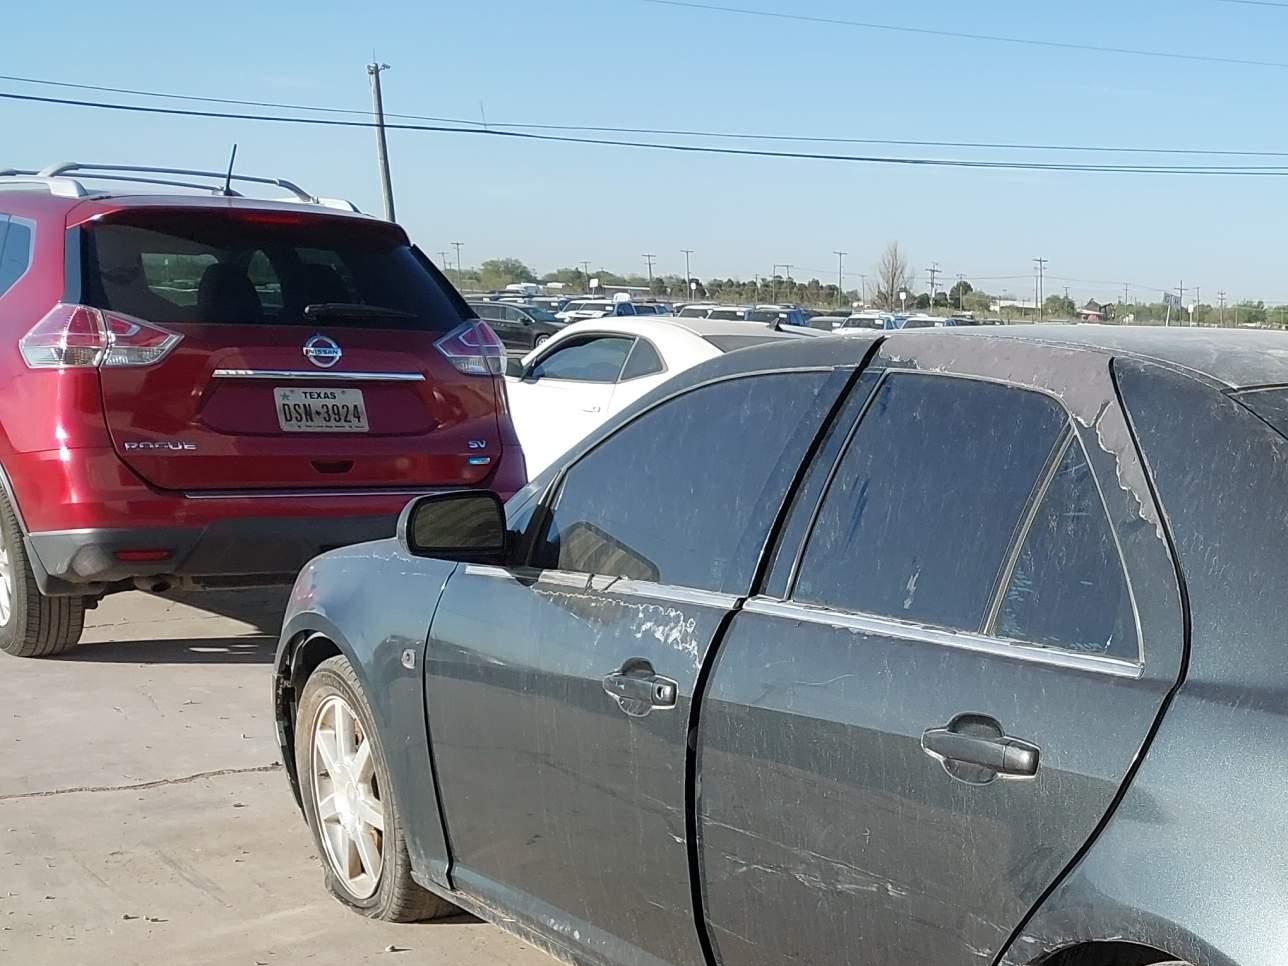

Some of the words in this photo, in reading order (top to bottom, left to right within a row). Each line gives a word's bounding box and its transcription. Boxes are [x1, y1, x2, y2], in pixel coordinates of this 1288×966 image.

[307, 348, 339, 356] NISSAN
[302, 391, 337, 400] TEXAS
[468, 439, 487, 448] SV
